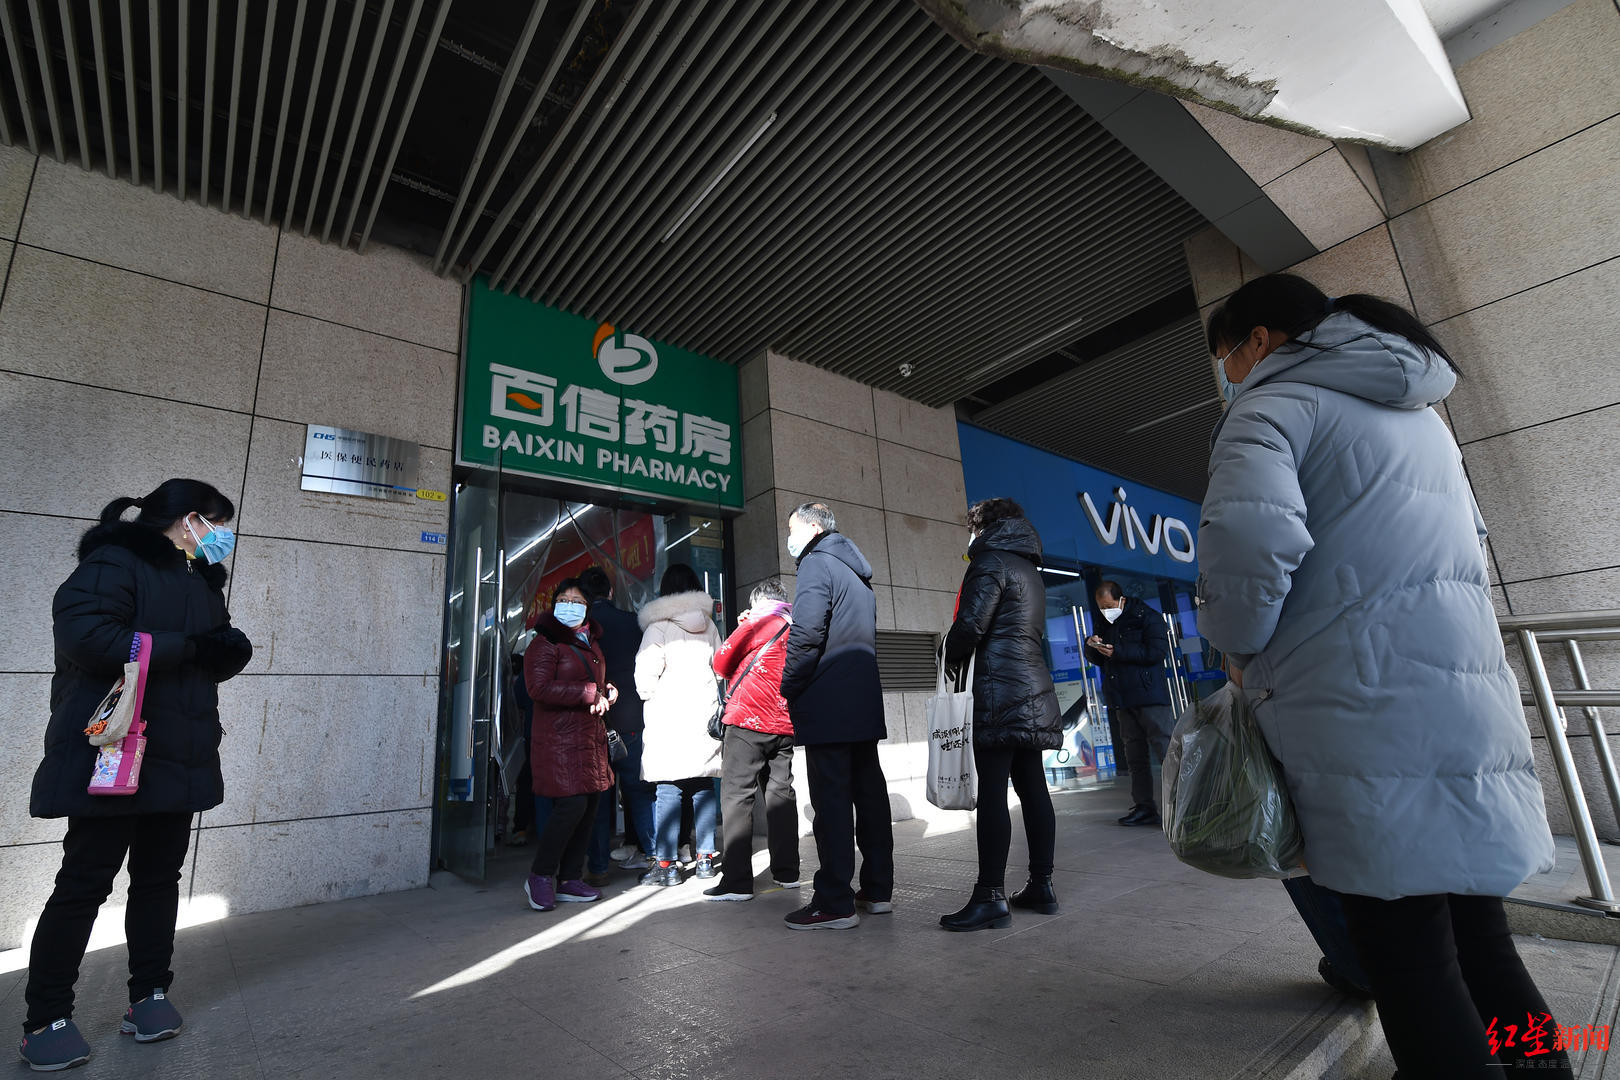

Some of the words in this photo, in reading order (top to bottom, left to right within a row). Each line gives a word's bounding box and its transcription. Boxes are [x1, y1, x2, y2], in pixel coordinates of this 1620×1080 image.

[313, 432, 336, 441] CHS
[489, 362, 731, 466] 百信药房
[320, 450, 404, 473] 医保便民药店
[482, 425, 585, 466] BAIXIN
[597, 448, 731, 493] PHARMACY
[421, 491, 435, 499] 102
[1078, 487, 1195, 564] vivo
